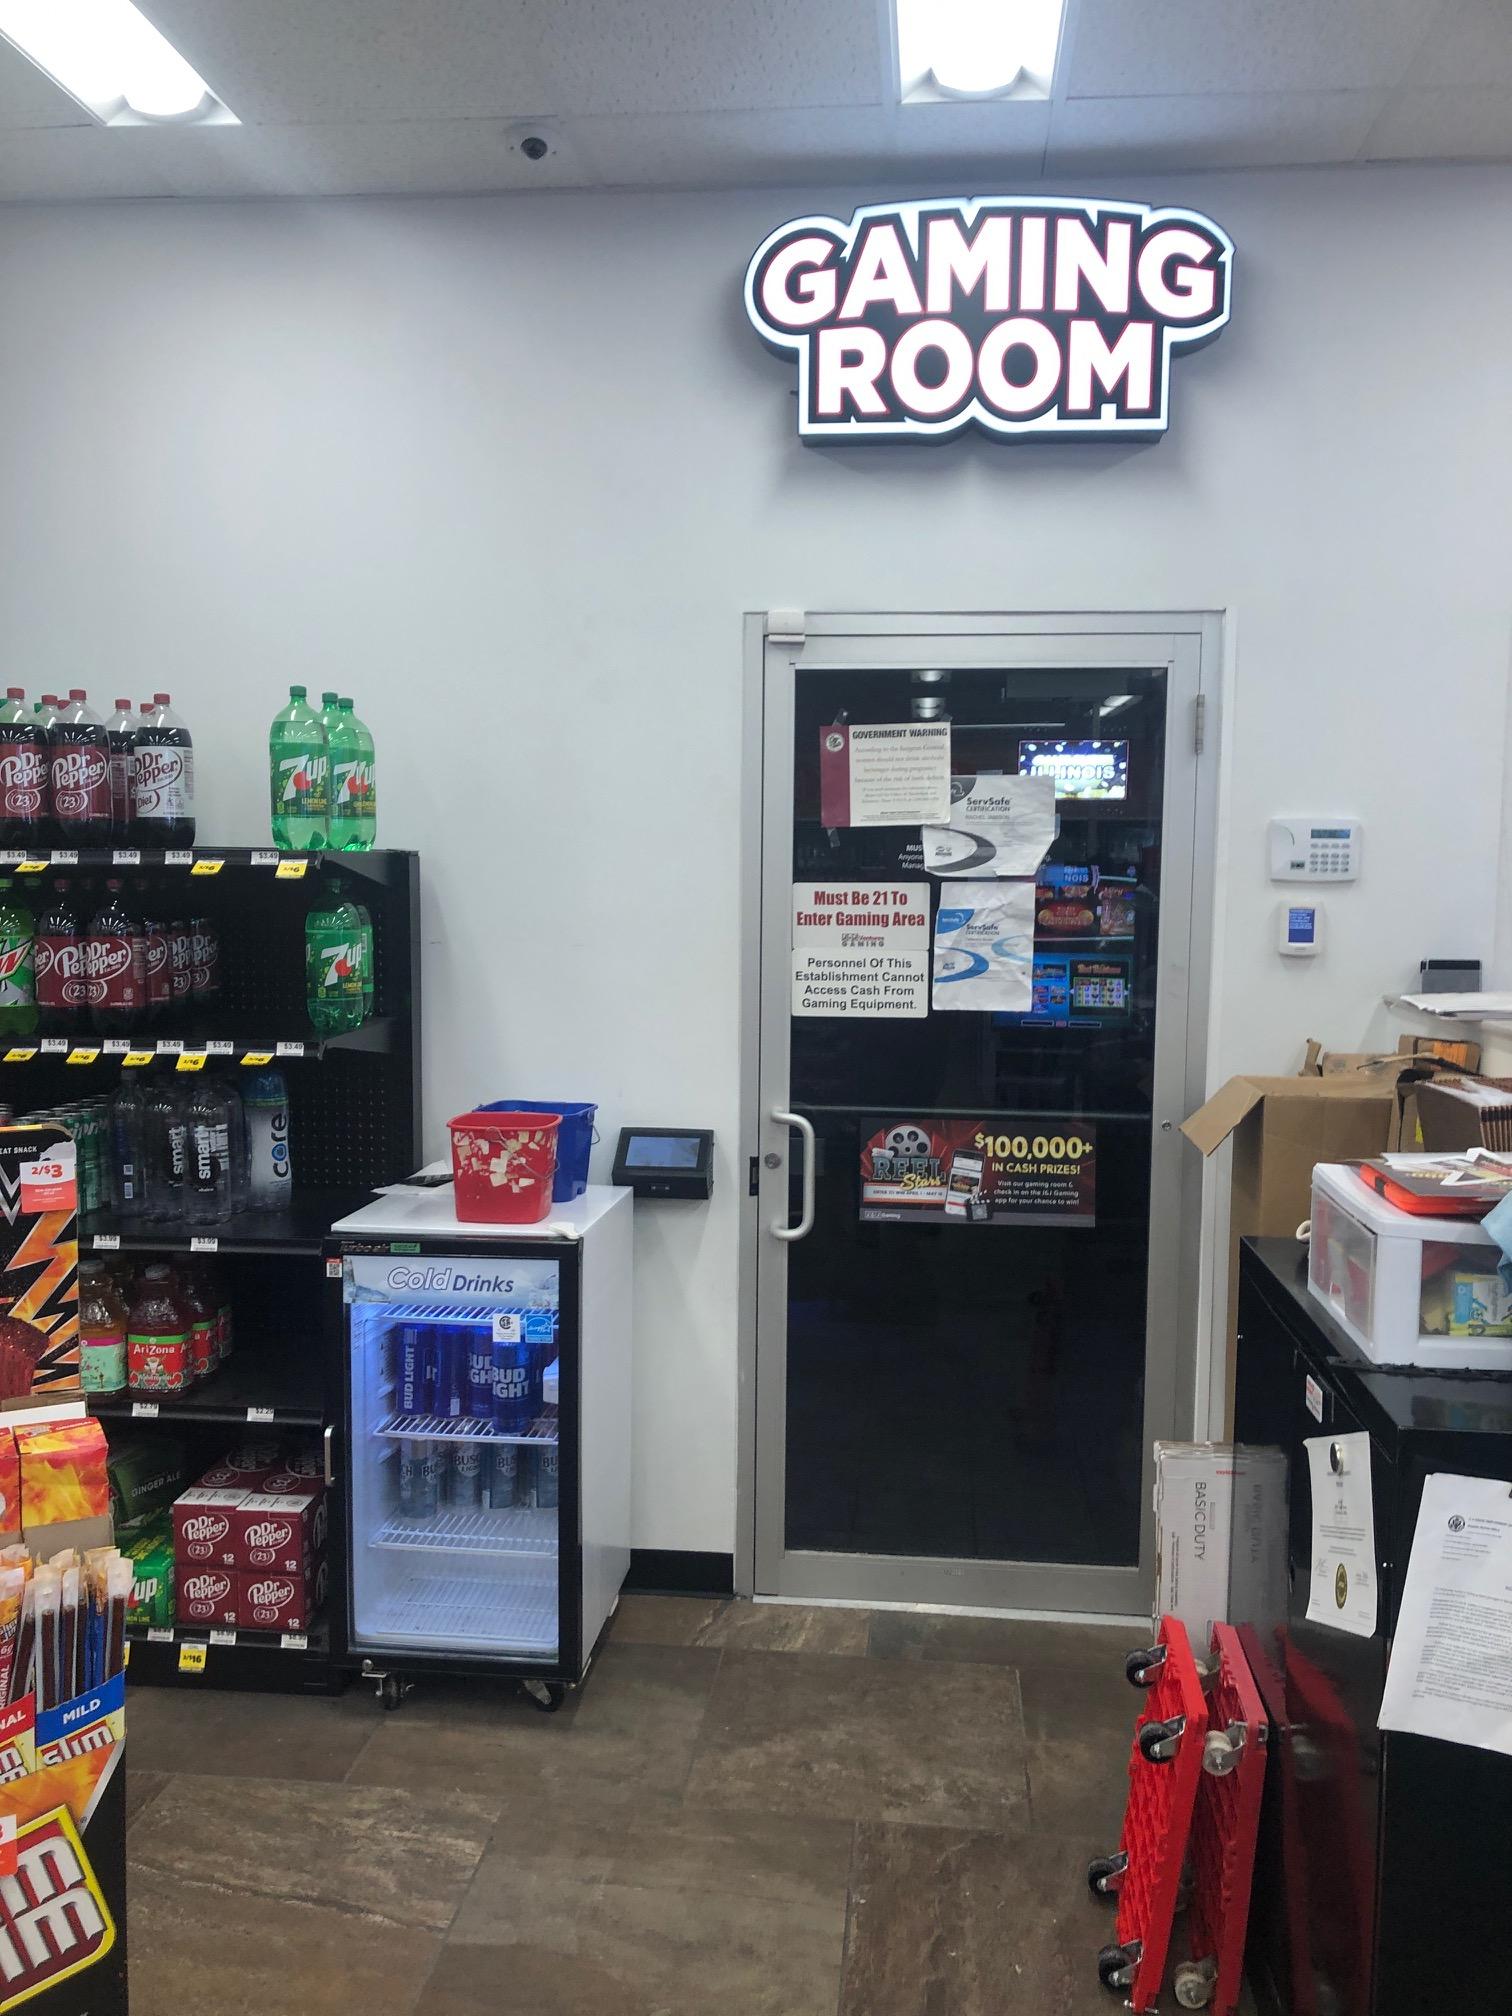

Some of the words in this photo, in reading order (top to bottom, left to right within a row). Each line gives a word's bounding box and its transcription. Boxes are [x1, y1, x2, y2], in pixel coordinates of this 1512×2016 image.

[759, 215, 1217, 327] GAMING
[815, 316, 1158, 417] ROOM
[852, 729, 908, 739] GOVERNMENT
[909, 727, 948, 737] WARNING
[20, 752, 42, 771] Dr
[66, 753, 91, 772] Dr
[141, 752, 163, 771] Dr
[52, 758, 104, 789] Pepper
[15, 794, 30, 807] 23
[63, 796, 76, 808] 23
[171, 851, 191, 859] $3.49
[259, 851, 278, 859] $3.49
[814, 890, 849, 905] Must
[851, 890, 870, 905] Be
[872, 890, 888, 905] 21
[891, 890, 908, 905] To
[796, 911, 833, 926] Enter
[835, 911, 890, 928] Gaming
[892, 911, 925, 926] Area
[807, 957, 866, 968] Personnel
[869, 957, 884, 968] Of
[886, 958, 912, 968] This
[795, 971, 879, 981] Establishment
[881, 971, 925, 982] Cannot
[804, 984, 847, 995] Access
[850, 985, 880, 995] Cash
[883, 986, 915, 995] From
[802, 998, 847, 1011] Gaming
[850, 999, 917, 1011] Equipment.
[48, 1039, 66, 1047] $3.49
[163, 1040, 181, 1048] $3.49
[974, 1132, 1093, 1161] $100,000+
[31, 1164, 63, 1179] 2/$3
[992, 1162, 1004, 1172] IN
[1006, 1162, 1038, 1173] CASH
[1040, 1163, 1080, 1175] PRIZES!
[900, 1173, 941, 1191] Stars
[386, 1266, 453, 1291] Cold
[452, 1274, 515, 1293] Drinks
[404, 1346, 415, 1383] LIGHT
[404, 1383, 414, 1410] BUD
[492, 1381, 529, 1398] IGHT
[131, 1477, 165, 1498] GINGER
[166, 1471, 182, 1483] ALE
[1194, 1481, 1207, 1524] BASIC
[199, 1515, 214, 1530] Dr
[261, 1522, 278, 1537] Dr
[183, 1519, 225, 1542] Pepper
[246, 1525, 288, 1547] Pepper
[195, 1545, 205, 1554] 23
[1194, 1524, 1206, 1561] DUTY
[222, 1553, 234, 1561] 12
[257, 1550, 267, 1559] 23
[285, 1560, 297, 1568] 12
[186, 1578, 227, 1600] Pepper
[200, 1574, 216, 1589] Dr
[263, 1580, 280, 1595] Dr
[249, 1584, 291, 1606] Pepper
[197, 1604, 206, 1613] 23
[224, 1612, 236, 1620] 12
[260, 1609, 269, 1618] 23
[288, 1618, 300, 1626] 12
[62, 1698, 101, 1724] MILD
[42, 1723, 115, 1767] slim
